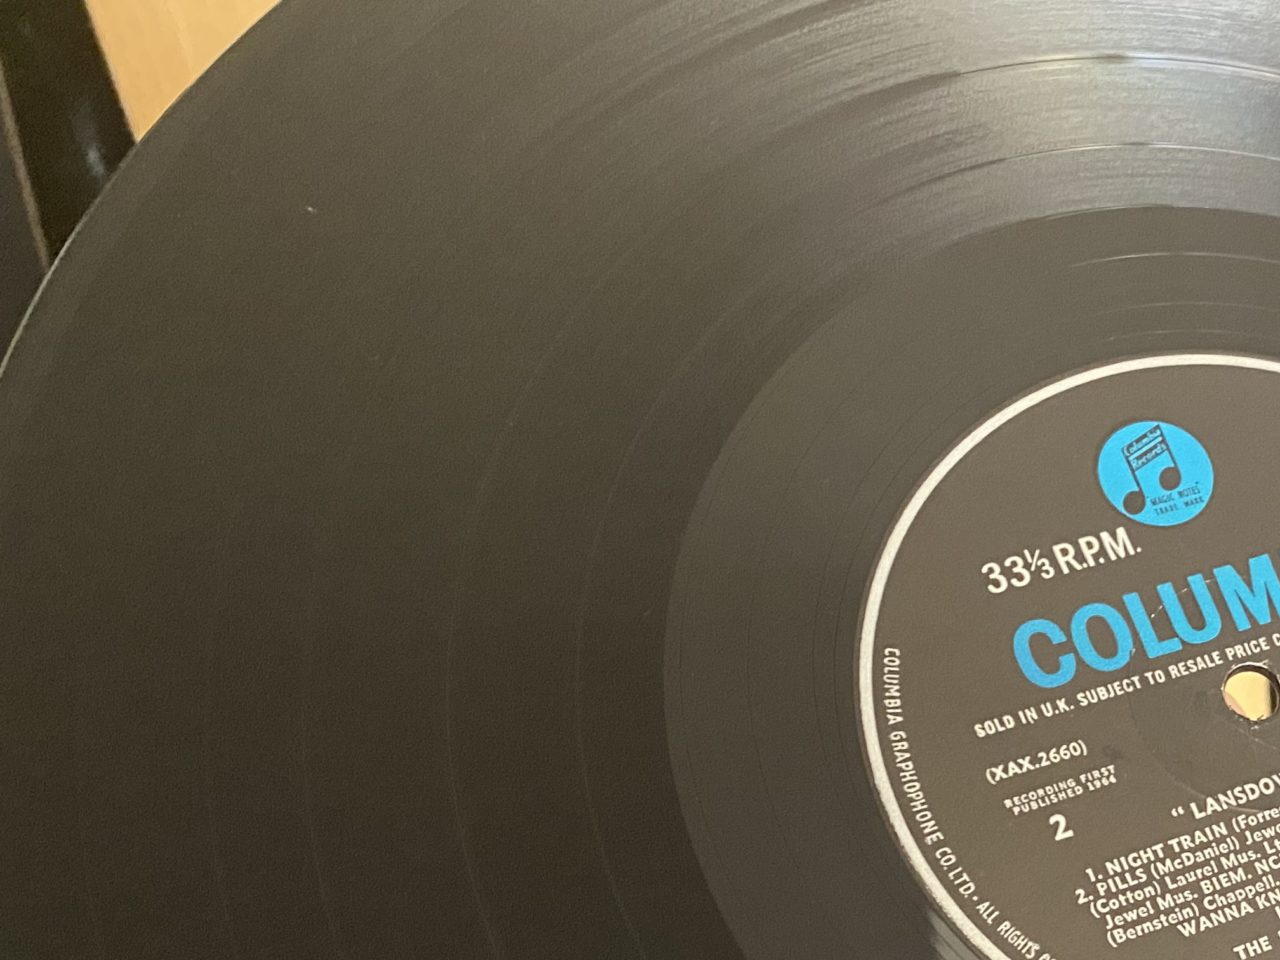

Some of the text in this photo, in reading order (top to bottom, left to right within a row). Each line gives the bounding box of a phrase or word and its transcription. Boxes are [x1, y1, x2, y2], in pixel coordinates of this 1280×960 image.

[1052, 526, 1142, 574] R.P.M.
[883, 647, 904, 725] COLUMBIA
[974, 714, 1015, 738] SOLD
[1018, 706, 1038, 725] IN
[1040, 697, 1074, 717] U.K.
[1076, 675, 1142, 707] SUBJECT
[1144, 669, 1166, 686] TO
[1168, 655, 1223, 679] RESALE
[1225, 636, 1270, 661] PRICE
[985, 739, 1088, 785] (XAX.2660)
[889, 730, 945, 845] GRAPHOPHONE
[1003, 764, 1116, 809] RECORDING FIRST
[1012, 774, 1118, 816] PUBLISHED 1964
[1048, 813, 1075, 841] 2
[1075, 888, 1093, 905] 2.
[1096, 867, 1147, 897] PILLS
[1150, 835, 1240, 880] (McDaniel)
[1085, 868, 1103, 883] 1.
[1104, 843, 1165, 876] NIGHT
[1167, 822, 1229, 853] TRAIN
[1089, 880, 1161, 919] (Cotton)
[1164, 860, 1217, 890] Laurel
[1220, 849, 1261, 870] Mus.
[1105, 900, 1154, 930] Jewel
[1156, 890, 1198, 912] Mus.
[1199, 867, 1252, 895] BIEM.
[976, 901, 1000, 924] ALL
[1106, 903, 1200, 948] (Bernstein)
[1203, 875, 1280, 912] Chappell.
[1176, 900, 1255, 938] WANNA
[997, 920, 1041, 959] RIGHTS
[1232, 936, 1273, 960] THE
